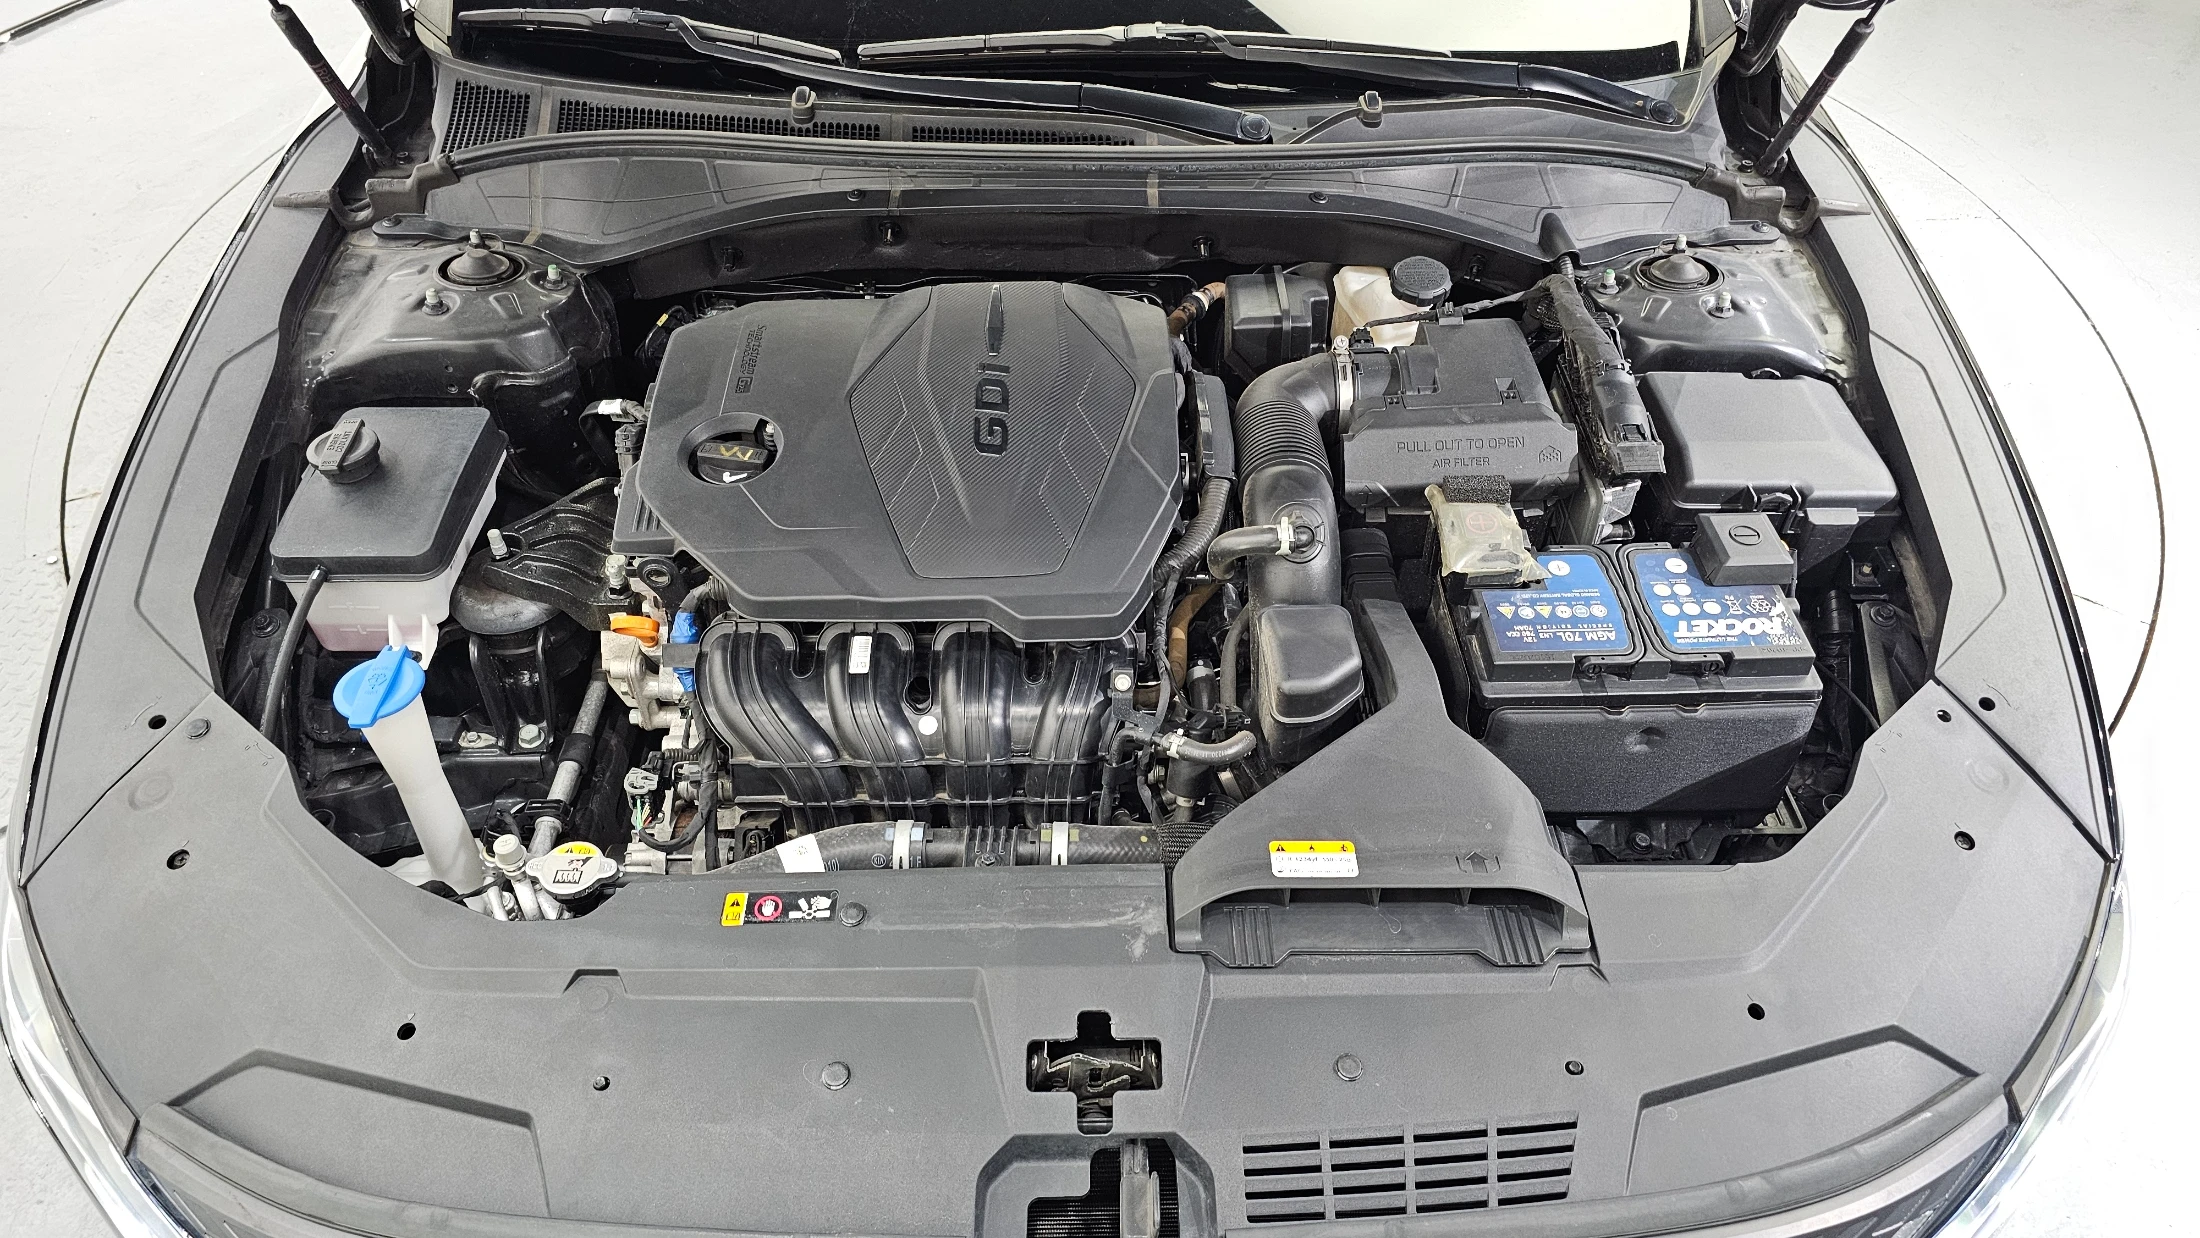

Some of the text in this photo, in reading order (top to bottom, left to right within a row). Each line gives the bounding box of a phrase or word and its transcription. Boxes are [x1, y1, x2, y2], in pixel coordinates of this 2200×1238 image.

[739, 329, 755, 375] TECHNOLOGY
[746, 324, 767, 375] Smartstream
[1396, 436, 1525, 453] PULL OUT TO OPEN
[1432, 457, 1490, 469] AIR FILTER
[1674, 616, 1784, 637] ROCKET
[1556, 631, 1582, 643] 70L
[1585, 630, 1616, 642] AGM
[872, 855, 885, 866] KIA
